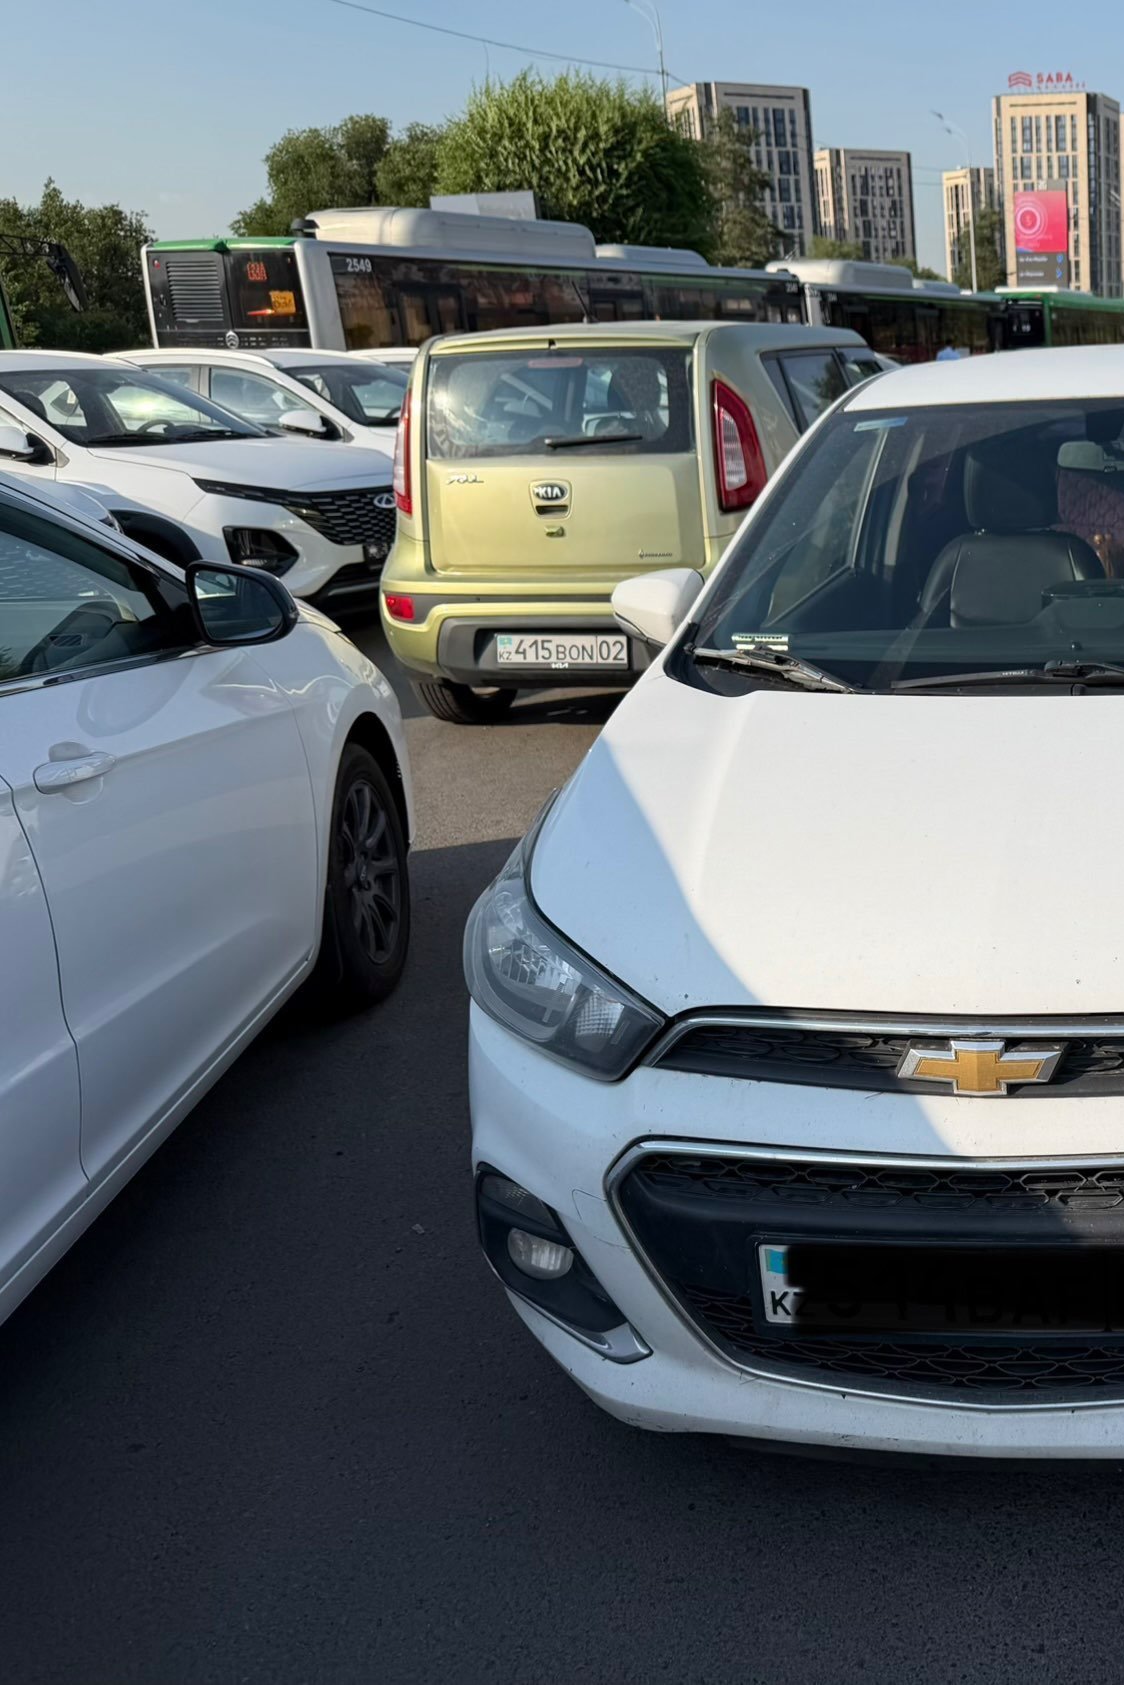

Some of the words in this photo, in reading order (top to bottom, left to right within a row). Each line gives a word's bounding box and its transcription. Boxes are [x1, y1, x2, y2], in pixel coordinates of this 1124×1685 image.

[1036, 72, 1073, 83] SABA
[346, 258, 372, 272] 2549
[537, 485, 563, 498] KIA
[499, 651, 513, 661] KZ
